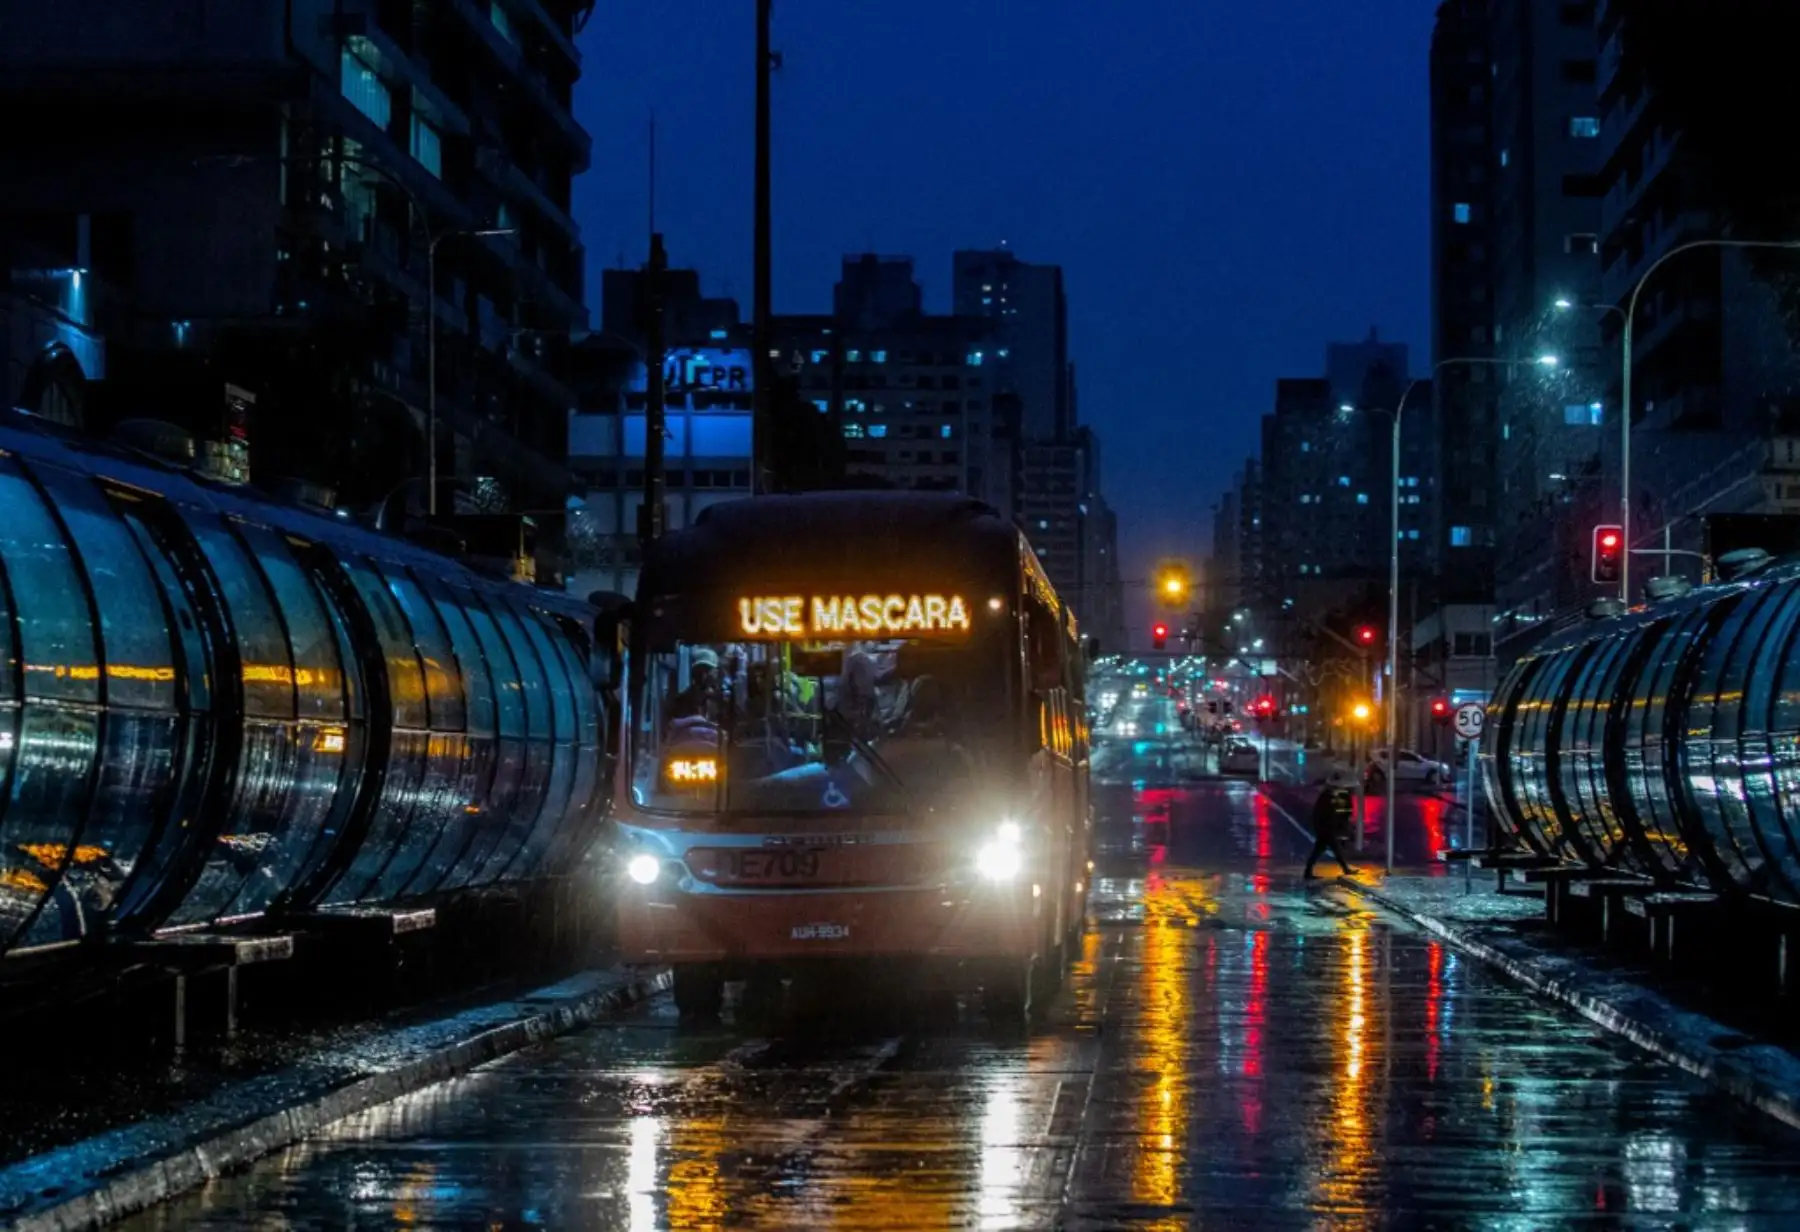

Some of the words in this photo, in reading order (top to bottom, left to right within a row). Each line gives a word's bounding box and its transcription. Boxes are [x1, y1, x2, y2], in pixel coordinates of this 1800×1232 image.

[739, 596, 803, 634] USE
[812, 594, 970, 631] MASCARA
[1459, 710, 1481, 726] 50
